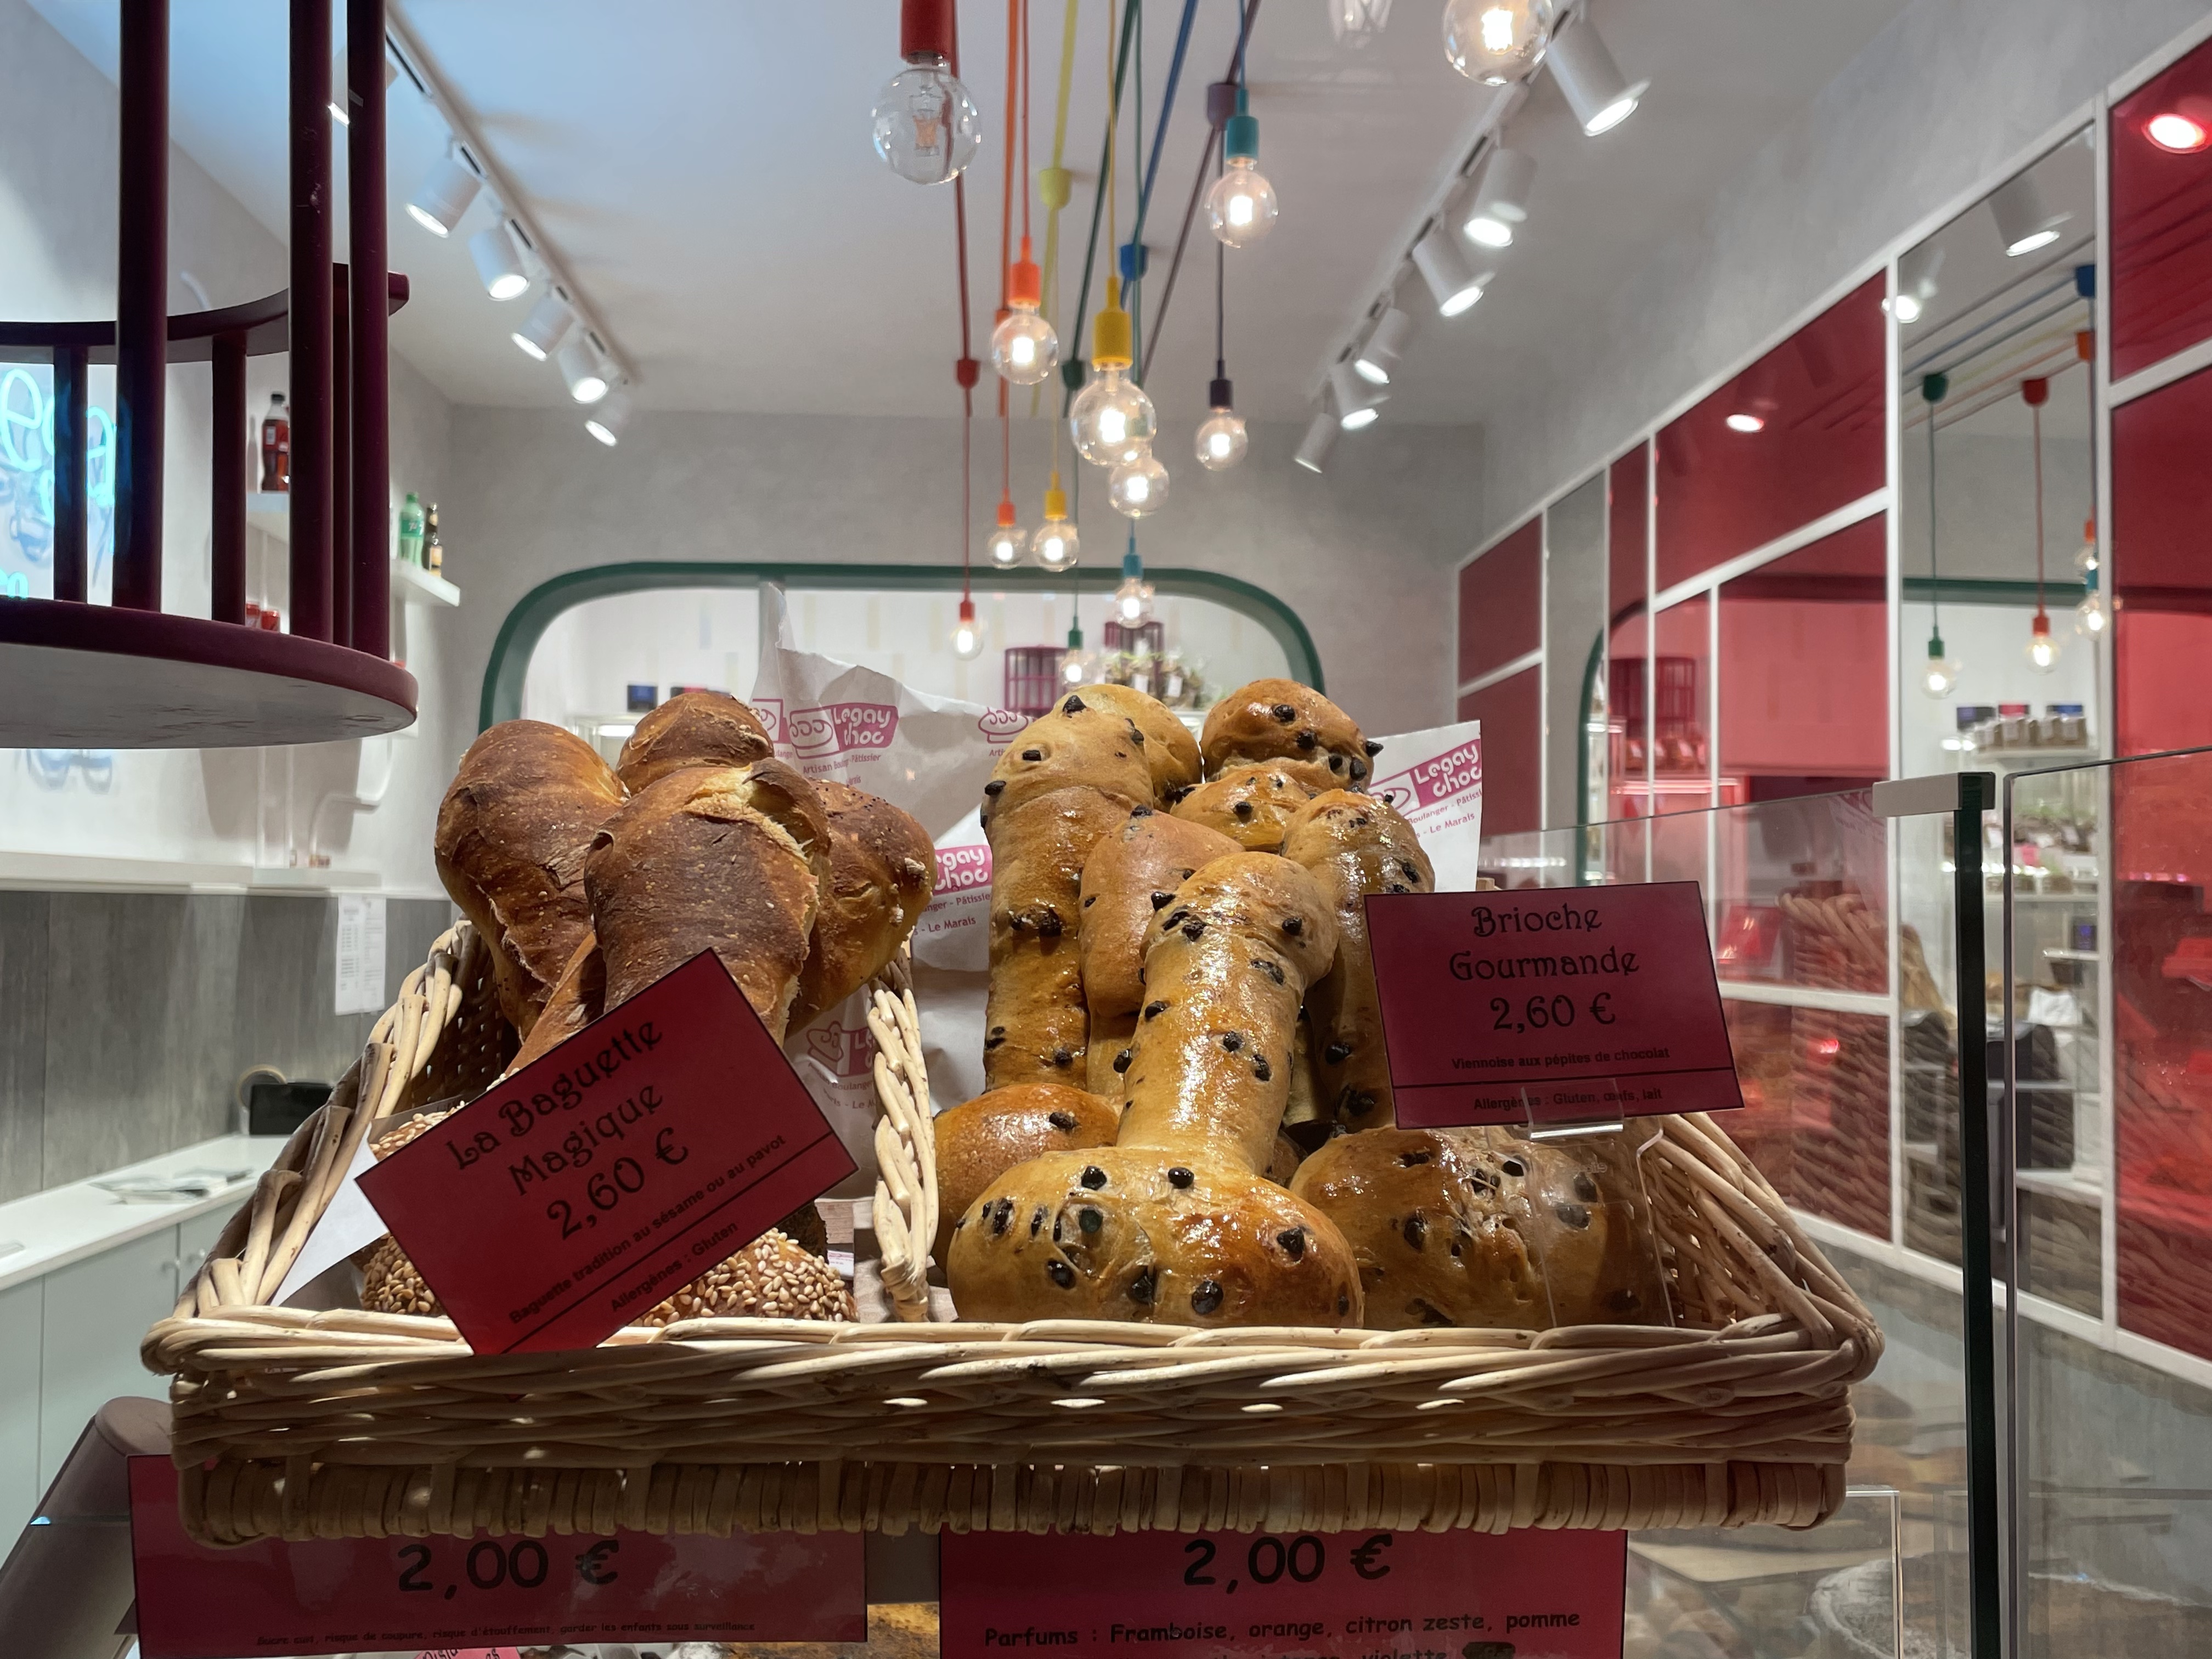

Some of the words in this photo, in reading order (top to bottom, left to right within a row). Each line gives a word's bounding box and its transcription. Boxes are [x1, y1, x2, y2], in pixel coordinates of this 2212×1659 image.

[803, 763, 833, 774] Artisan
[851, 754, 882, 763] Pâtissier
[1414, 744, 1479, 785] Legay
[1432, 766, 1482, 797] choc
[1430, 825, 1441, 833] Le
[1445, 812, 1475, 828] Marais
[935, 849, 985, 871] gay
[956, 893, 991, 905] Pâtissie
[928, 923, 940, 933] Le
[944, 916, 977, 929] Marais
[1471, 902, 1602, 937] Brioche
[1449, 945, 1640, 980] Gourmande
[1489, 994, 1575, 1033] 2,60
[1589, 992, 1616, 1024] €
[1452, 1057, 1514, 1069] Viennoise
[1519, 1057, 1541, 1066] aux
[1545, 1053, 1591, 1068] pépites
[1595, 1051, 1610, 1062] de
[1615, 1048, 1670, 1060] chocolat
[445, 1131, 502, 1170] La
[498, 1022, 663, 1137] Baguette
[1641, 1088, 1662, 1100] lait
[508, 1085, 663, 1195] Magique
[547, 1157, 645, 1240] 2,60
[656, 1127, 689, 1165] €
[509, 1279, 572, 1324] Baguette
[572, 1240, 631, 1281] tradition
[633, 1226, 651, 1242] au
[652, 1189, 704, 1229] sésame
[707, 1176, 725, 1193] ou
[727, 1163, 745, 1180] au
[747, 1134, 786, 1169] pavot
[611, 1260, 683, 1312] Allergènes
[692, 1222, 738, 1256] Gluten
[398, 1539, 549, 1600] 2,00
[574, 1539, 620, 1584] €
[1183, 1536, 1325, 1594] 2,00
[1350, 1533, 1393, 1580] €
[363, 1632, 376, 1640] de
[433, 1629, 466, 1639] risque
[560, 1624, 597, 1635] garder
[601, 1622, 616, 1631] les
[620, 1622, 661, 1632] enfants
[694, 1622, 755, 1631] surveillance
[985, 1627, 1079, 1646] Parfums
[1110, 1622, 1235, 1644] Framboise,
[1249, 1620, 1333, 1641] orange,
[1346, 1616, 1413, 1634] citron
[1423, 1613, 1493, 1633] zeste,
[1506, 1613, 1581, 1634] pomme
